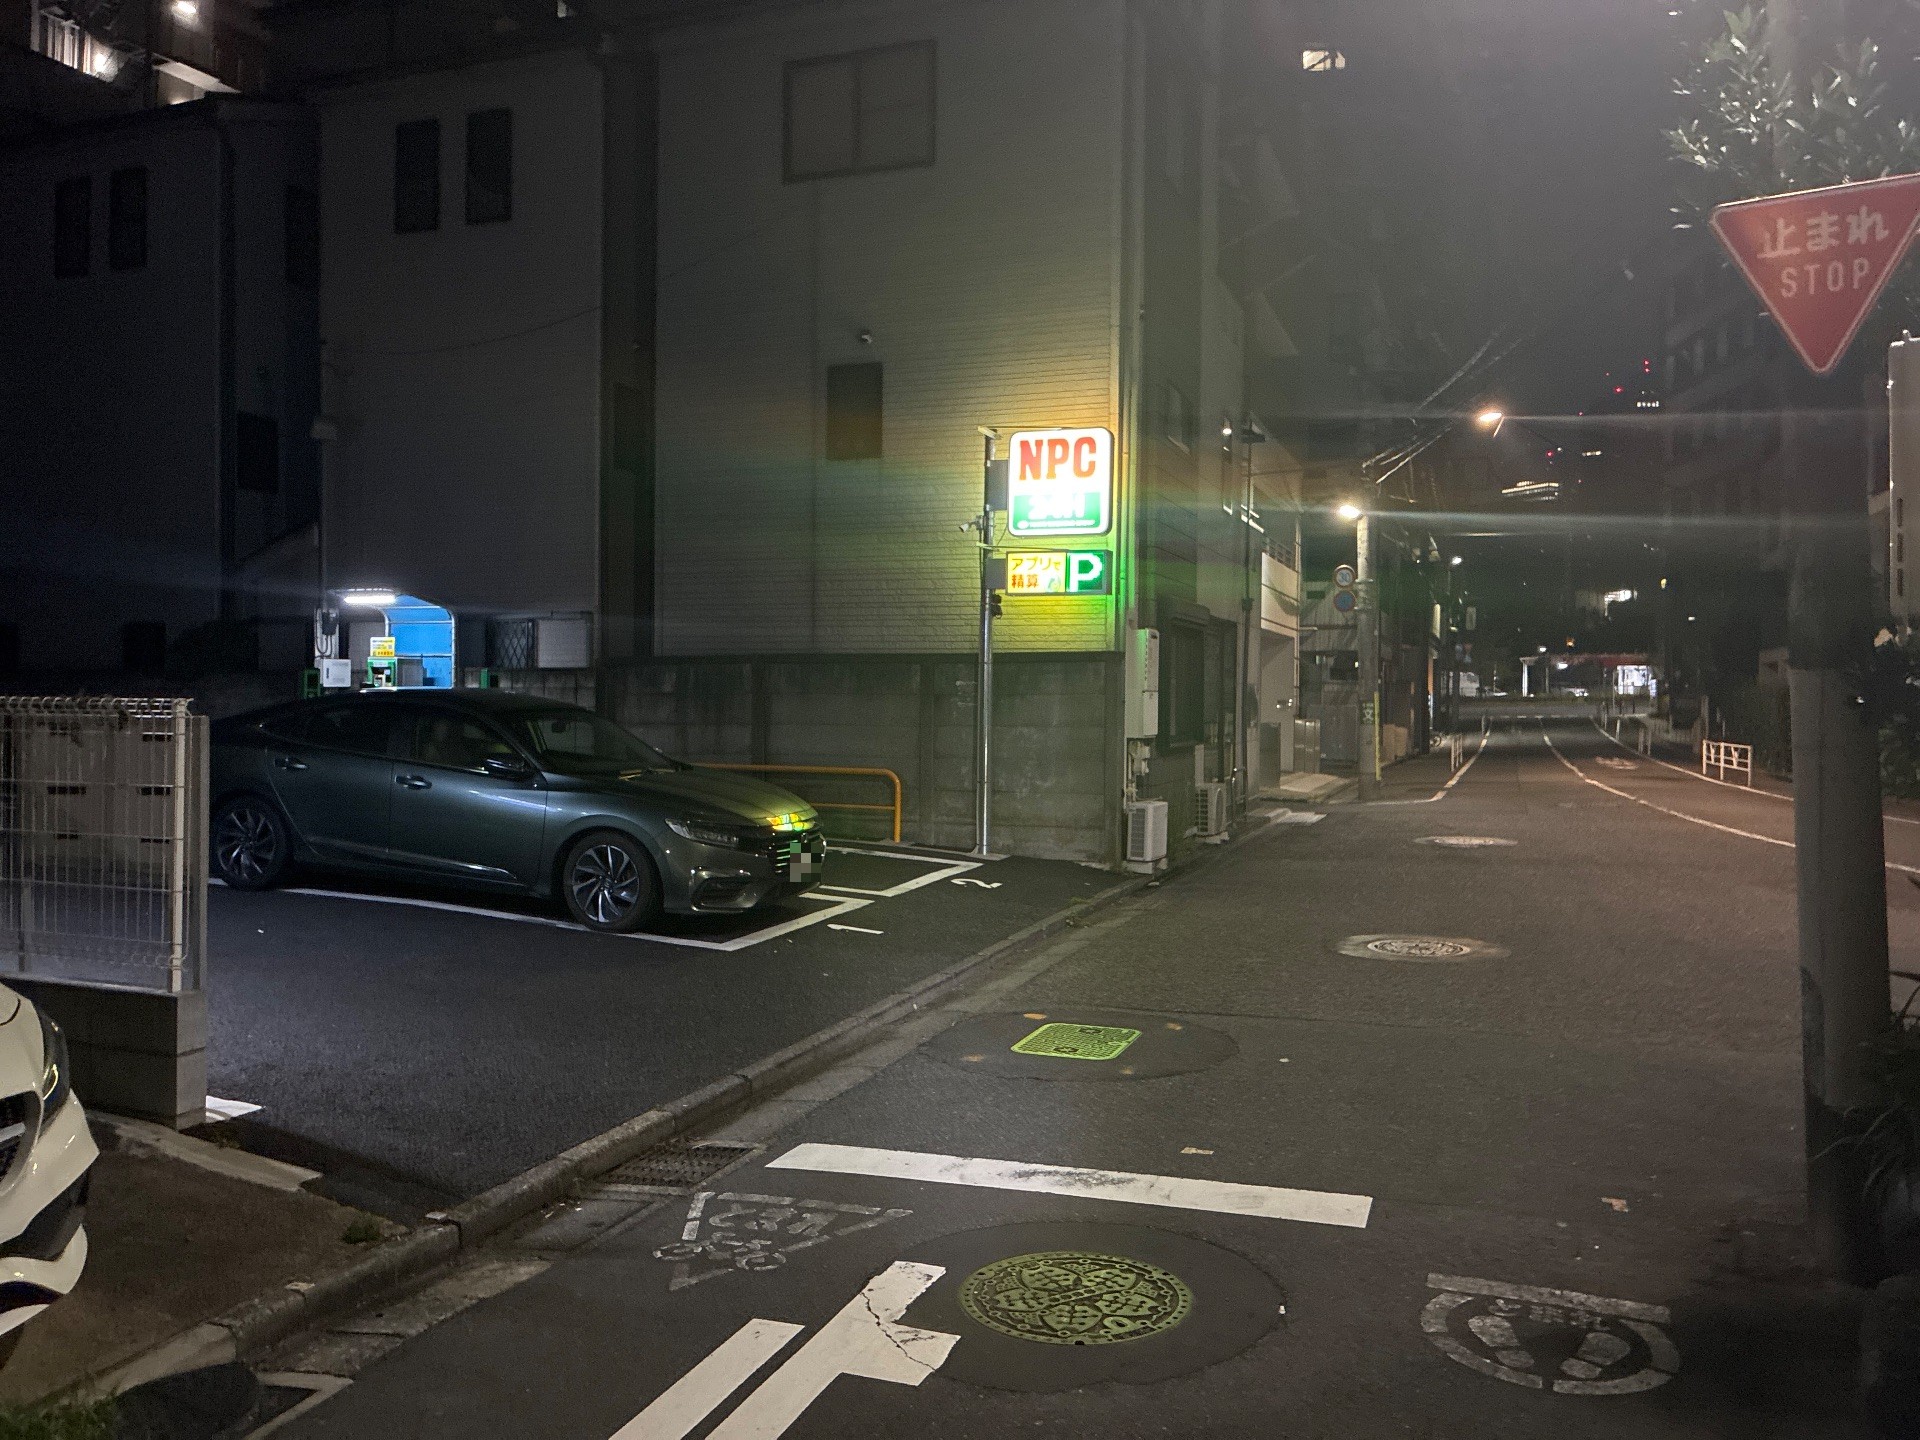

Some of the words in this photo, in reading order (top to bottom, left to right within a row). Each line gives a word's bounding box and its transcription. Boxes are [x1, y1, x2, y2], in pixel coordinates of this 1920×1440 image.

[1756, 205, 1889, 259] 止まれ
[1780, 257, 1870, 298] STOP
[1019, 436, 1097, 481] NPC
[1011, 574, 1038, 588] 精算
[1069, 553, 1103, 593] P
